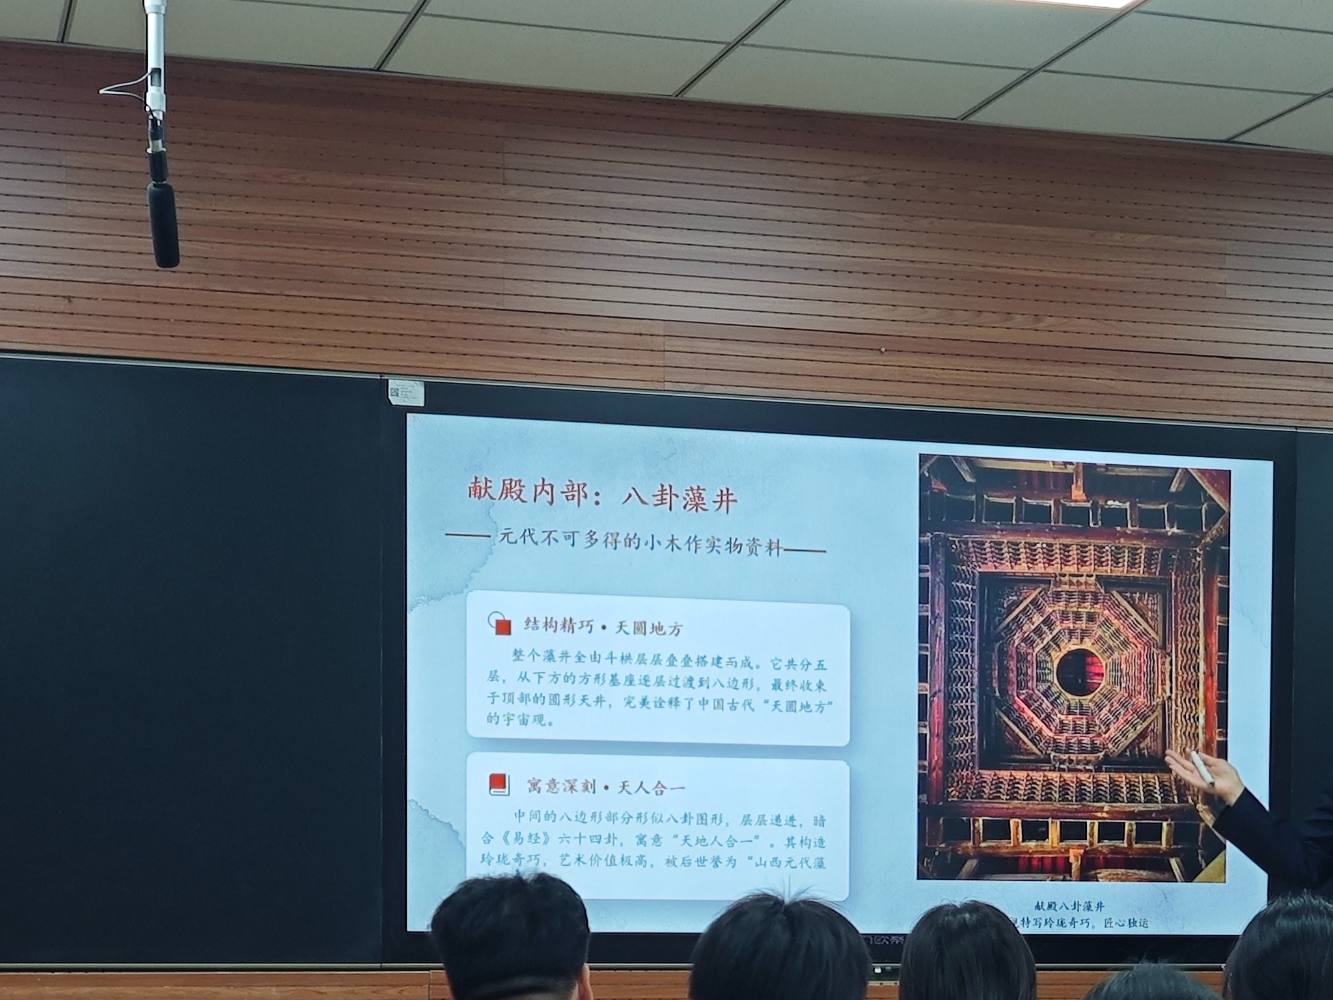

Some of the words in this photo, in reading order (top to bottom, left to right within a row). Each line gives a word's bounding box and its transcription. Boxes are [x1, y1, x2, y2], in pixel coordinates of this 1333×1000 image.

[468, 476, 738, 515] 献殿内部：八卦藻井
[486, 711, 554, 727] 的宇宙观。
[1034, 900, 1106, 913] 献殿八卦藻井
